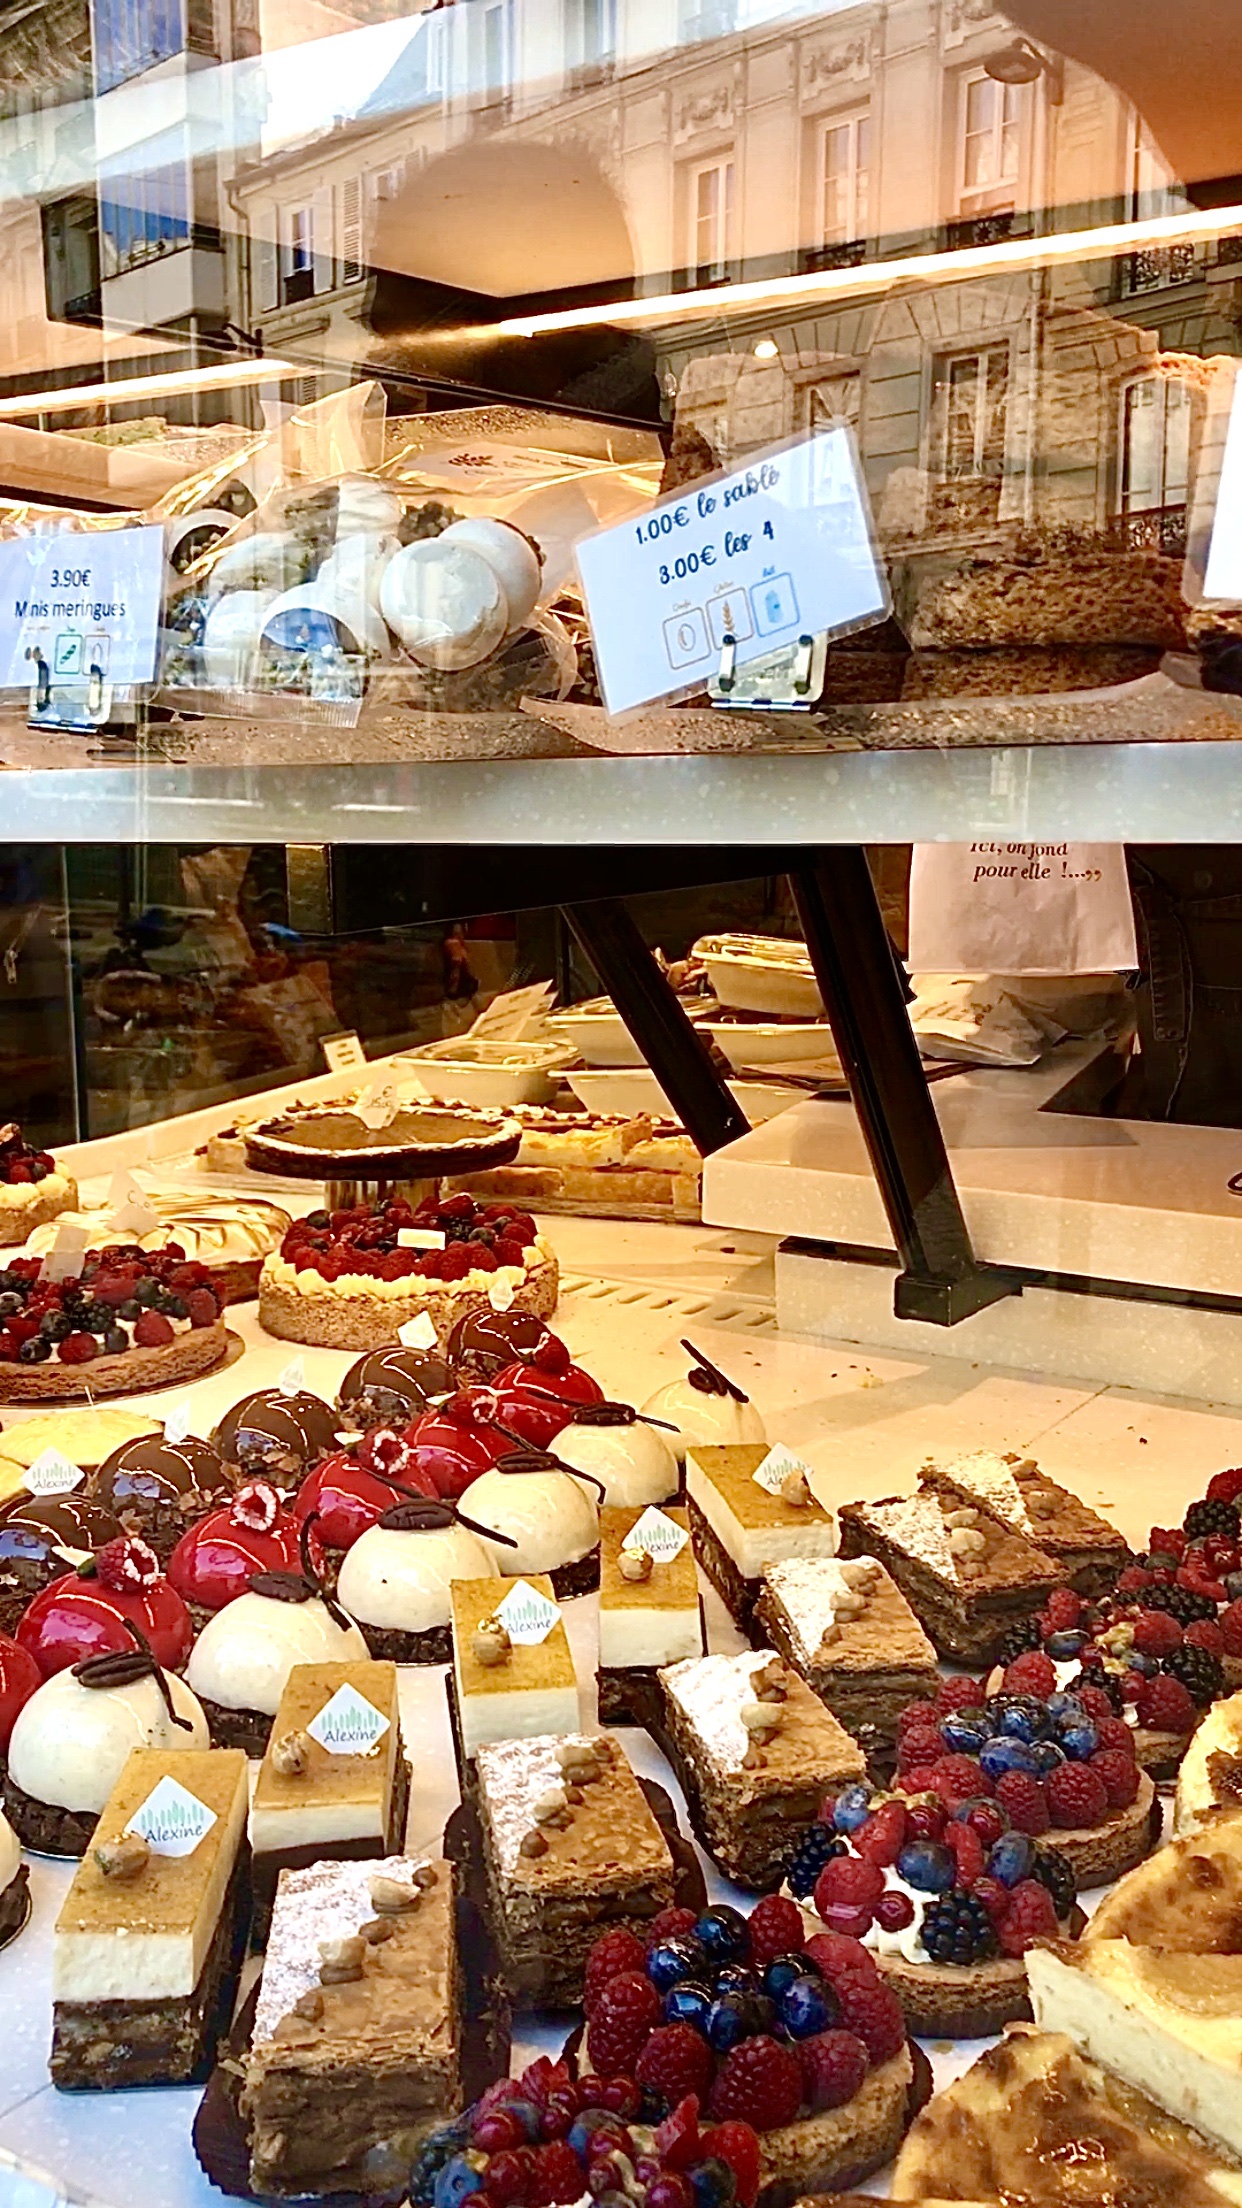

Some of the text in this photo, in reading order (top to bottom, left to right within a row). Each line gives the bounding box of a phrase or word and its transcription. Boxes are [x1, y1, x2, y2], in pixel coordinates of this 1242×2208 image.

[635, 505, 691, 545] 1.00€
[658, 520, 775, 585] 3.00€ les 4
[50, 568, 92, 588] 3.90€
[52, 598, 126, 621] meringues
[973, 864, 1018, 883] pour
[1019, 862, 1051, 880] elle
[323, 1726, 377, 1743] Alexine
[146, 1823, 204, 1842] Alexine
